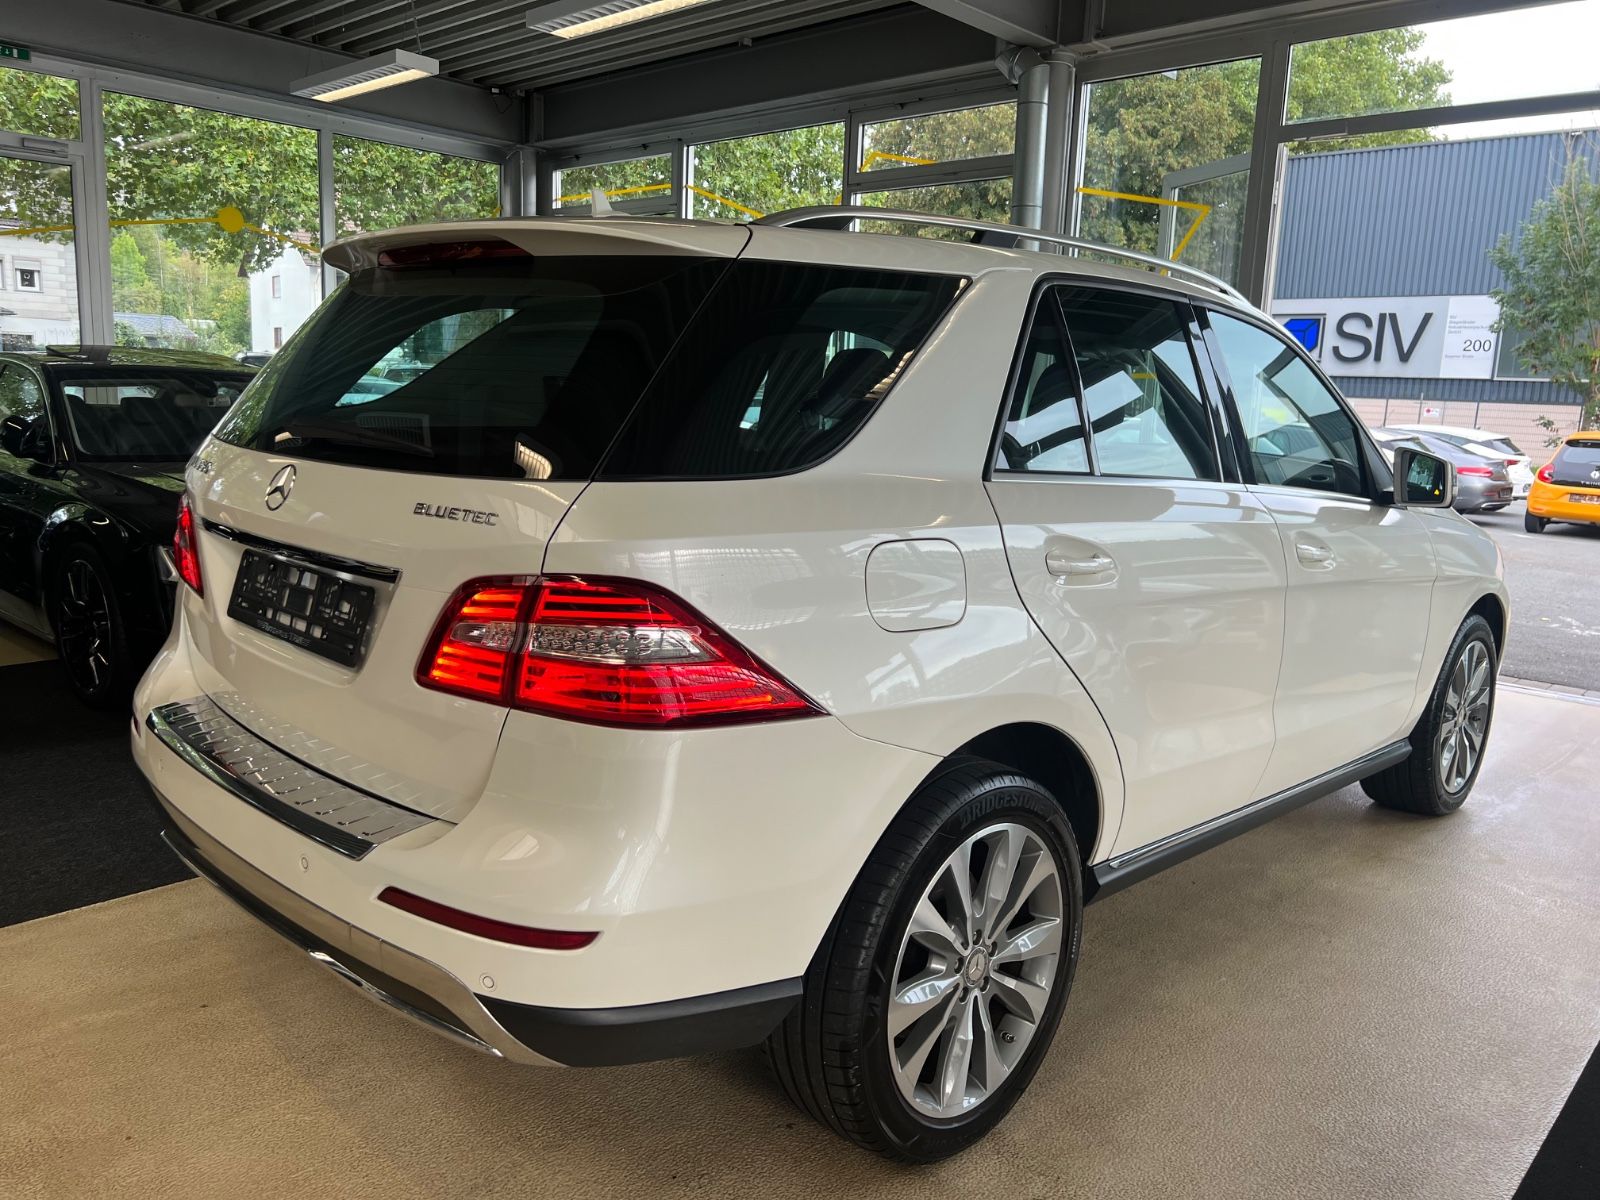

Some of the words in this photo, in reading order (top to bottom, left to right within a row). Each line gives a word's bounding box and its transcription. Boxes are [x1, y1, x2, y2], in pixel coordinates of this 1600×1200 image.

[1332, 312, 1433, 362] SIV
[1463, 339, 1492, 352] 200
[413, 502, 499, 526] BLUETEC
